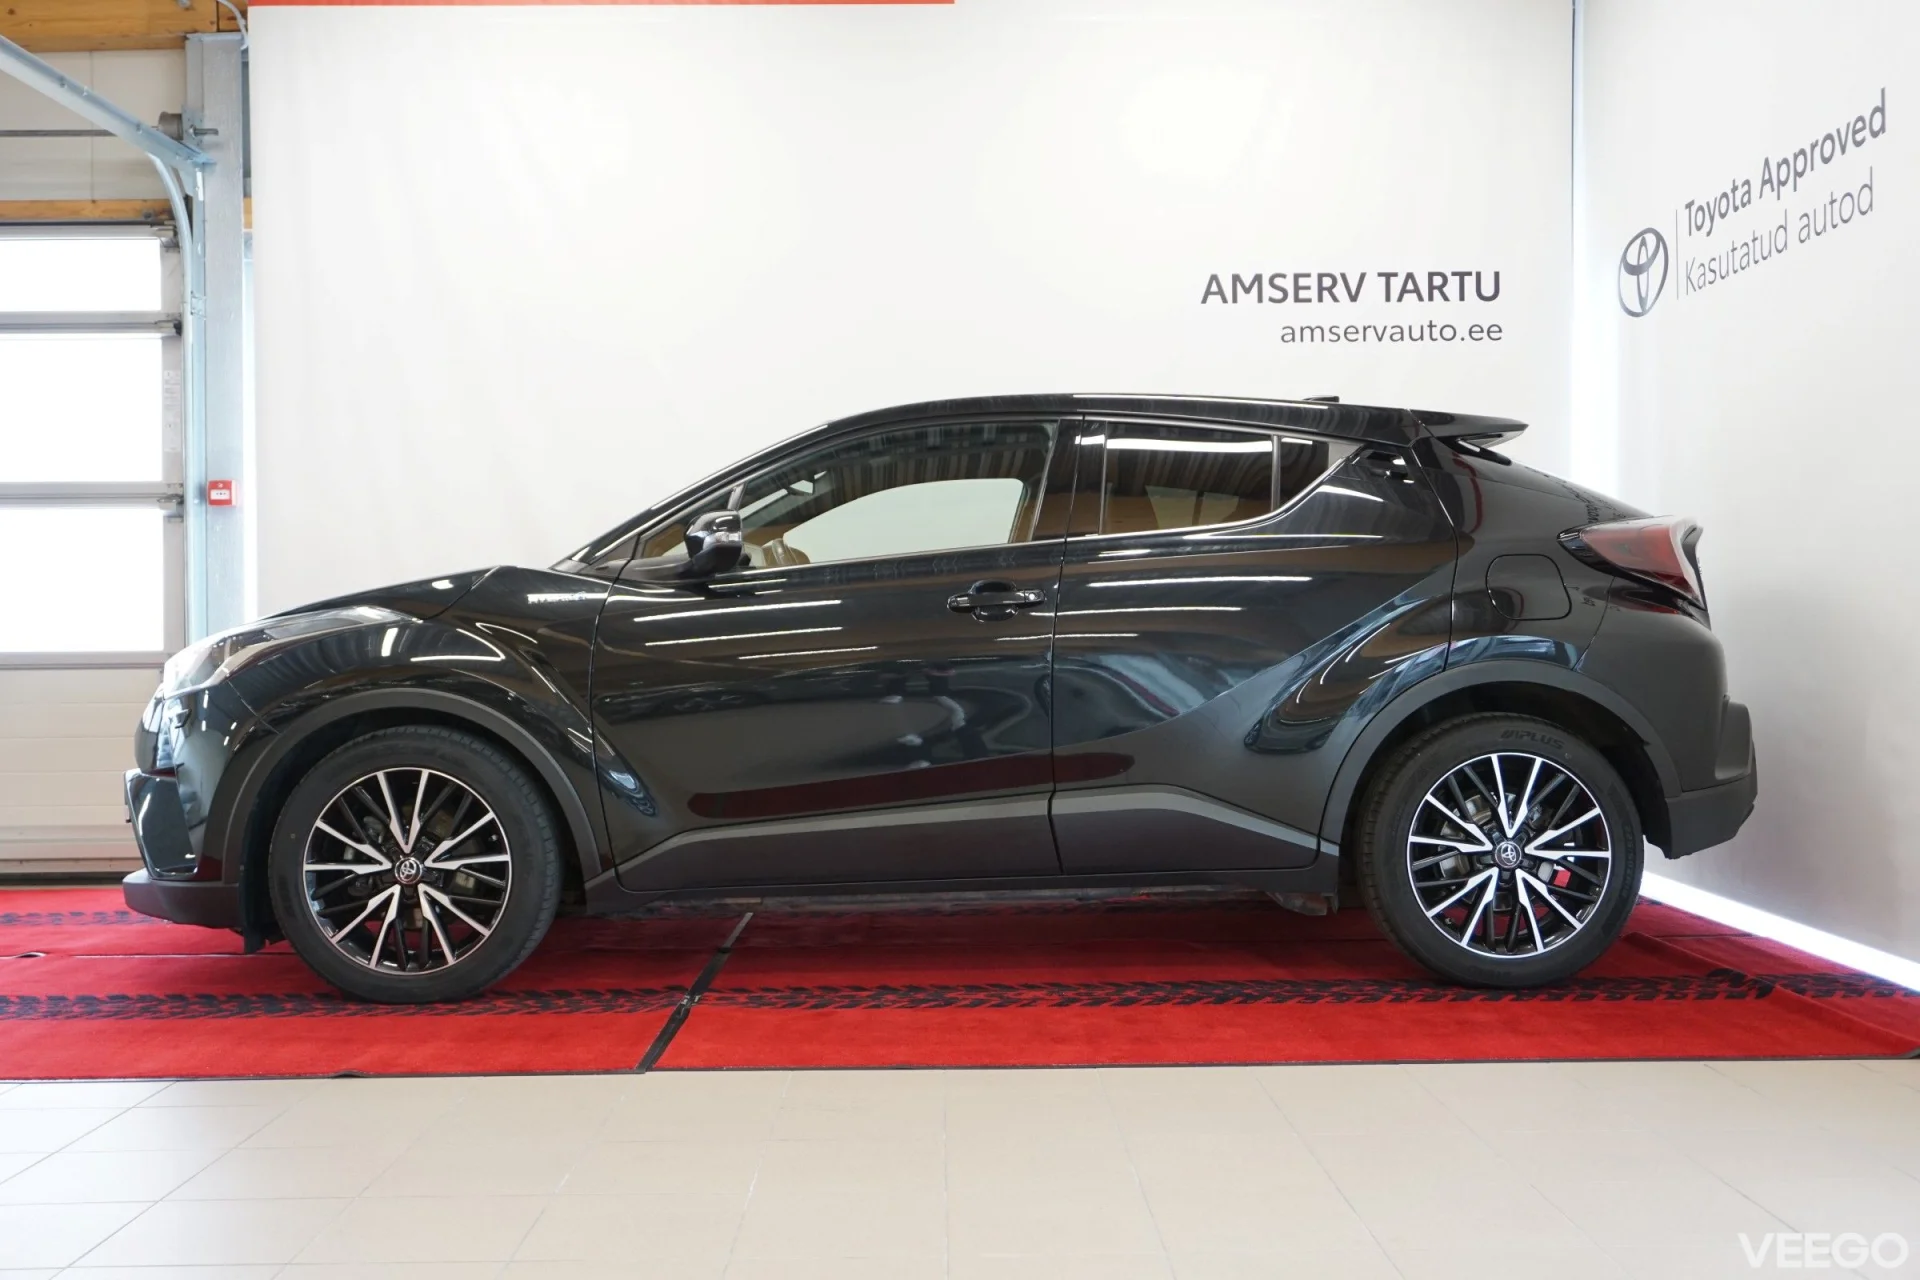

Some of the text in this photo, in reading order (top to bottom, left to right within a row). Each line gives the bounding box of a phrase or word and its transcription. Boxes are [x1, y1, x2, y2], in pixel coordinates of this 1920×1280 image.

[1684, 86, 1886, 237] Toyota Approved
[1685, 165, 1873, 295] Kasutatud autod
[1200, 271, 1501, 304] AMSERV TARTU
[1280, 320, 1502, 343] amservauto.ee
